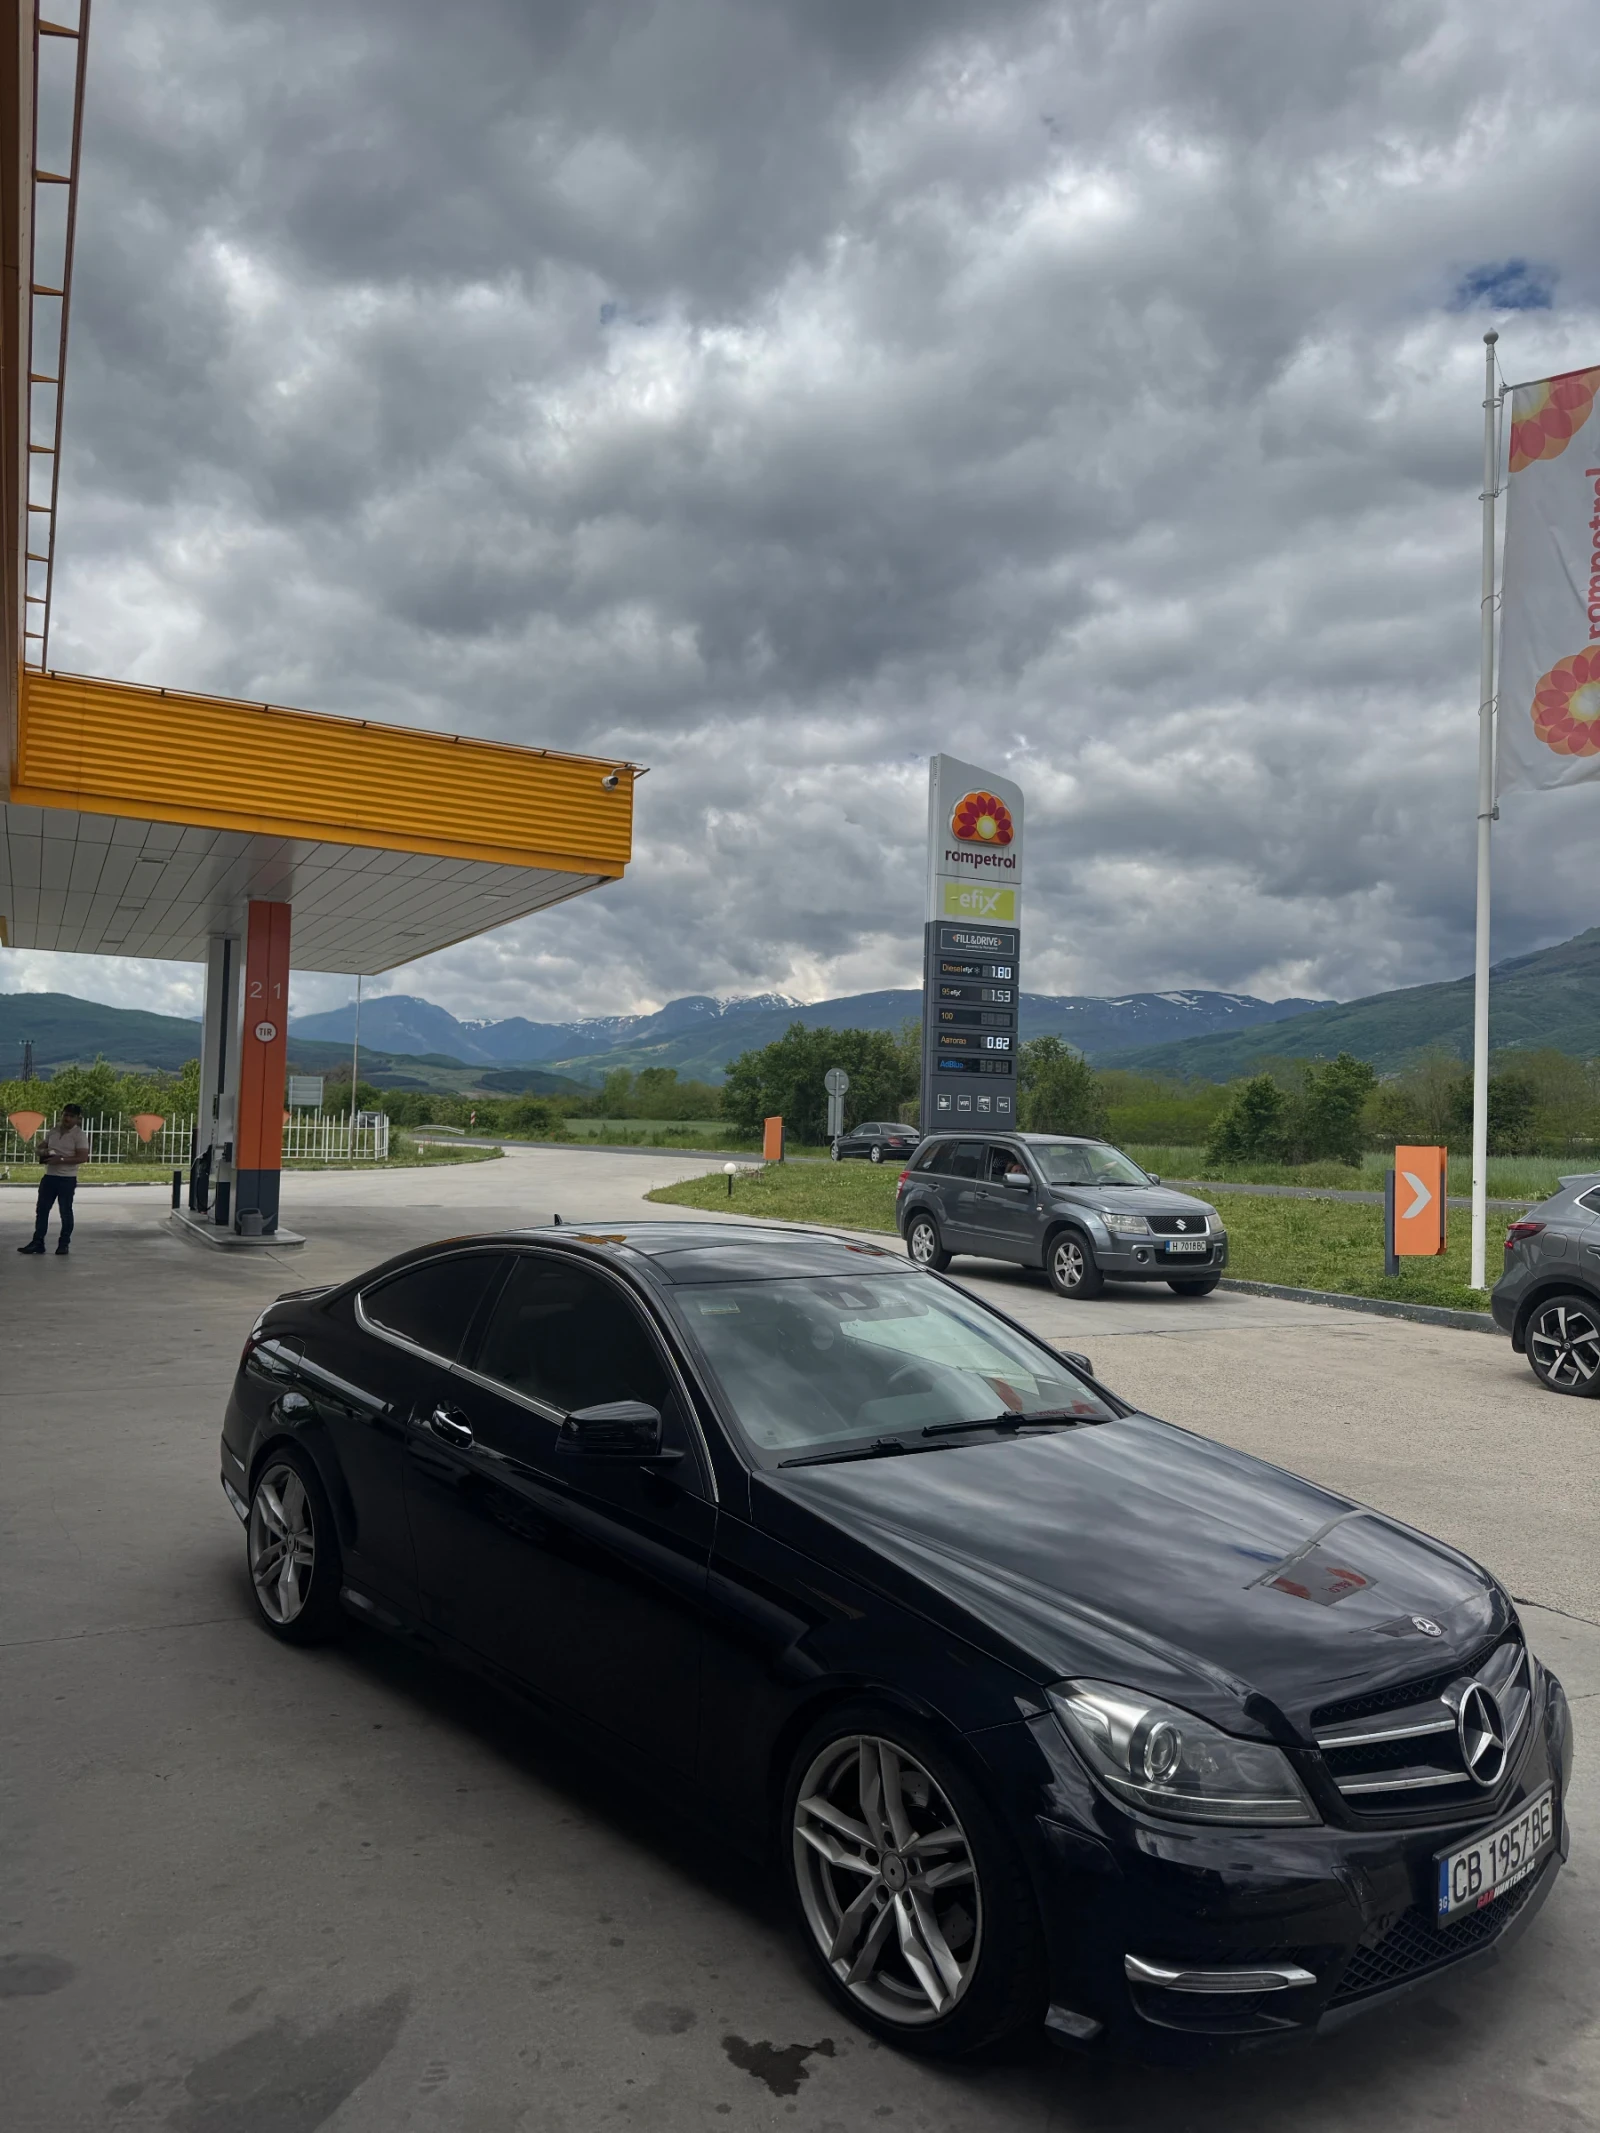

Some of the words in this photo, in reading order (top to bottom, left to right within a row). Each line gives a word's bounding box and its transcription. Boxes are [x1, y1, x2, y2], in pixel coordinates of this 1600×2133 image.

[945, 849, 1016, 869] rompetrol
[960, 889, 1002, 915] efix
[956, 933, 998, 947] FILL&DRIVE
[991, 965, 1012, 979] 1.80
[250, 981, 262, 999] 2
[273, 982, 281, 1000] 1
[991, 989, 1011, 1003] 1.53
[941, 1012, 954, 1020] 100
[259, 1027, 273, 1037] TIR
[986, 1036, 1010, 1050] 0.82
[1453, 1850, 1483, 1904] CB
